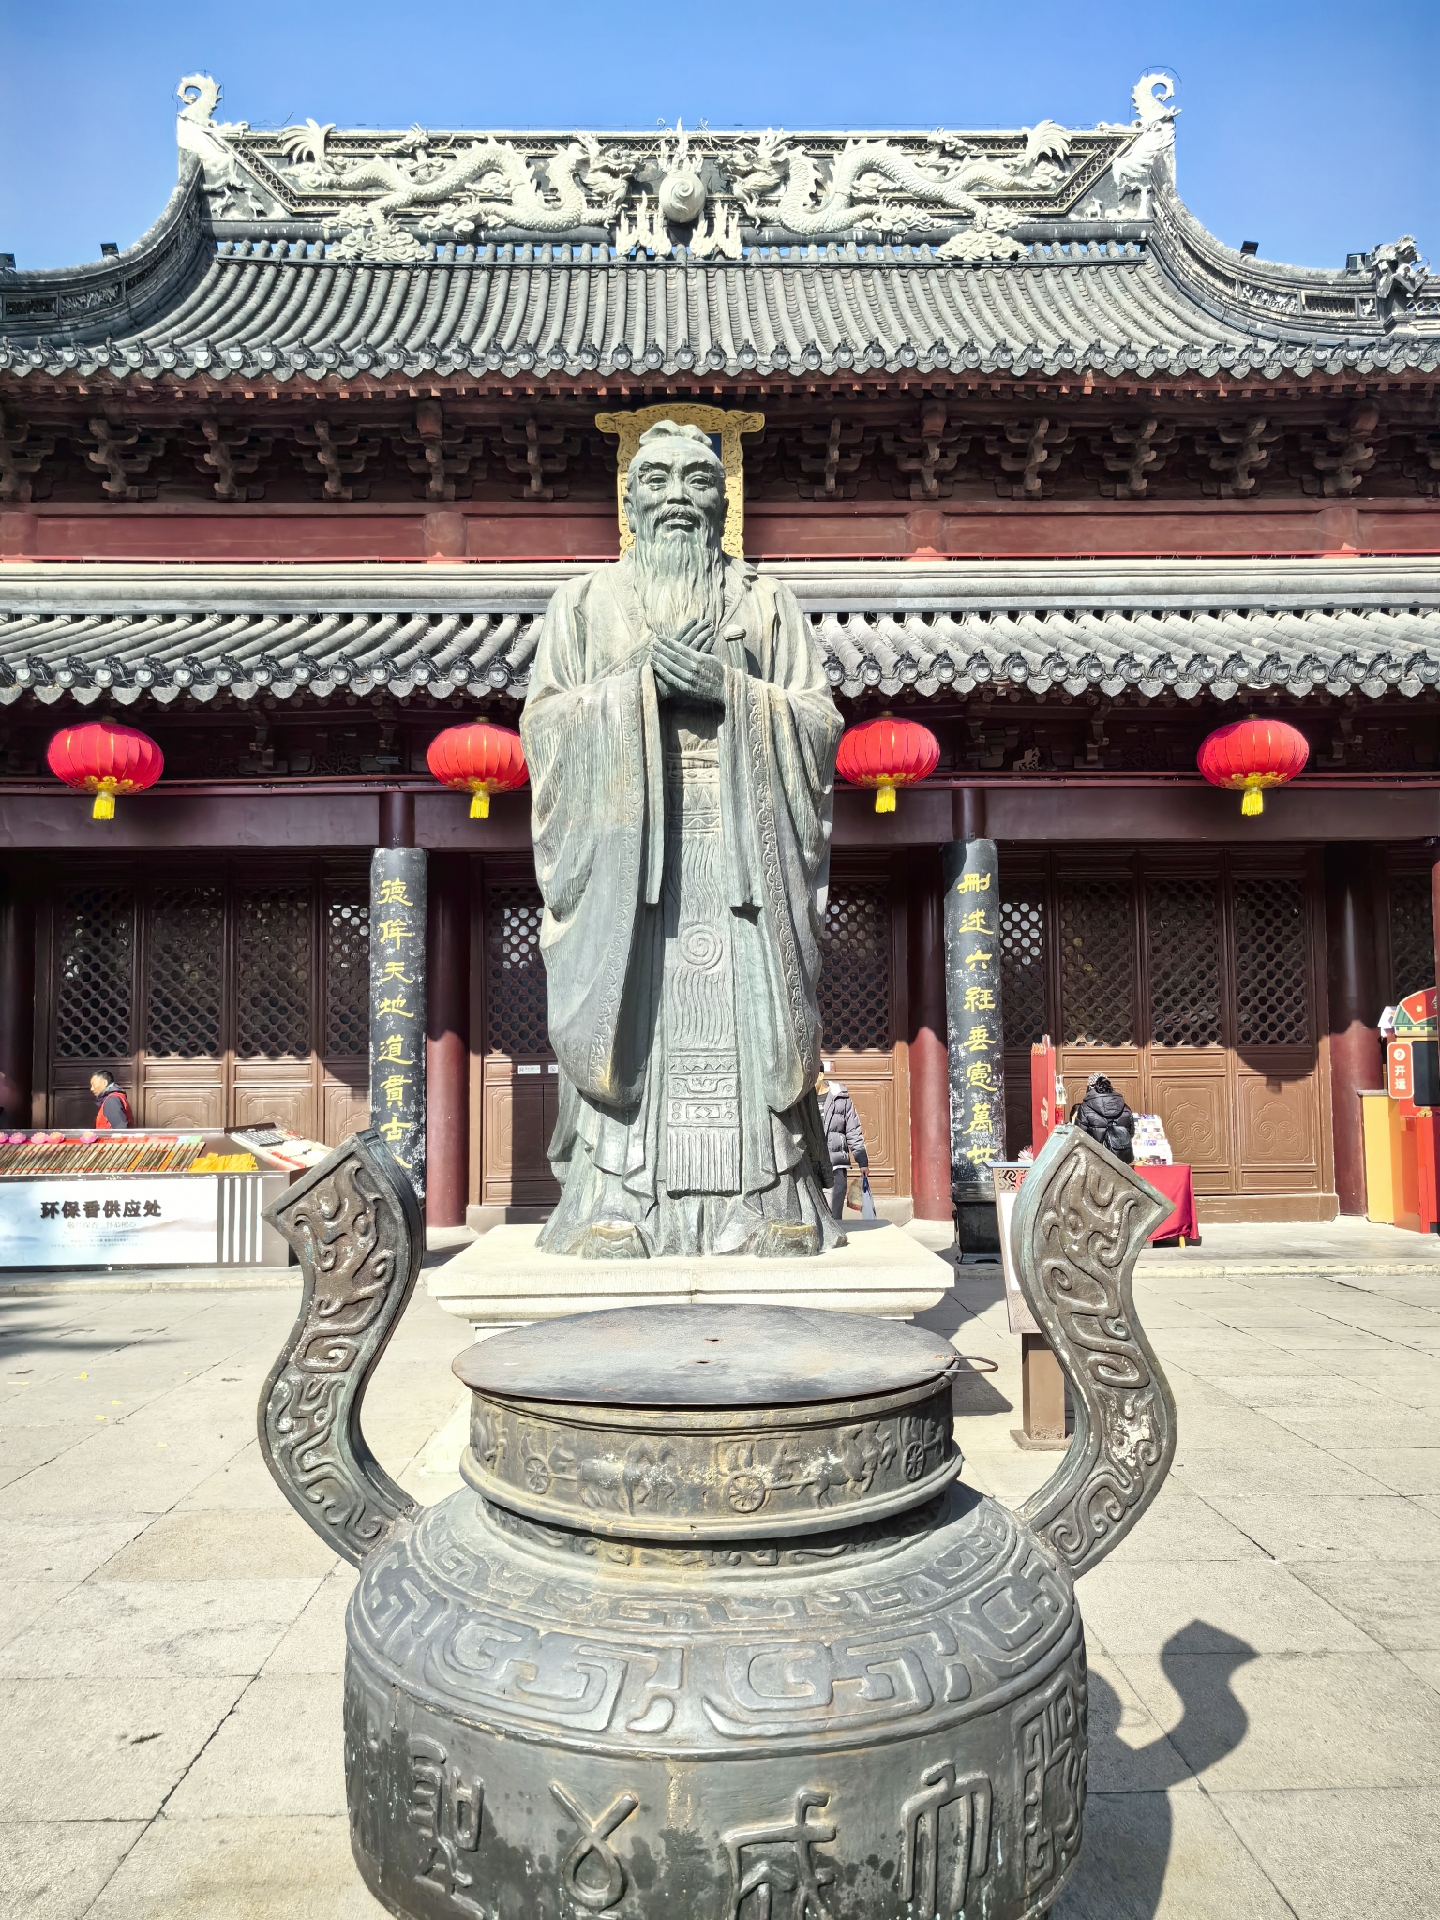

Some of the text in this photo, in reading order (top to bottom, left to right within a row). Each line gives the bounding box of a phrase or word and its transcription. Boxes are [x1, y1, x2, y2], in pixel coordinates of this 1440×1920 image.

[1395, 1065, 1406, 1090] 开运
[41, 1200, 161, 1219] 环保香供应处
